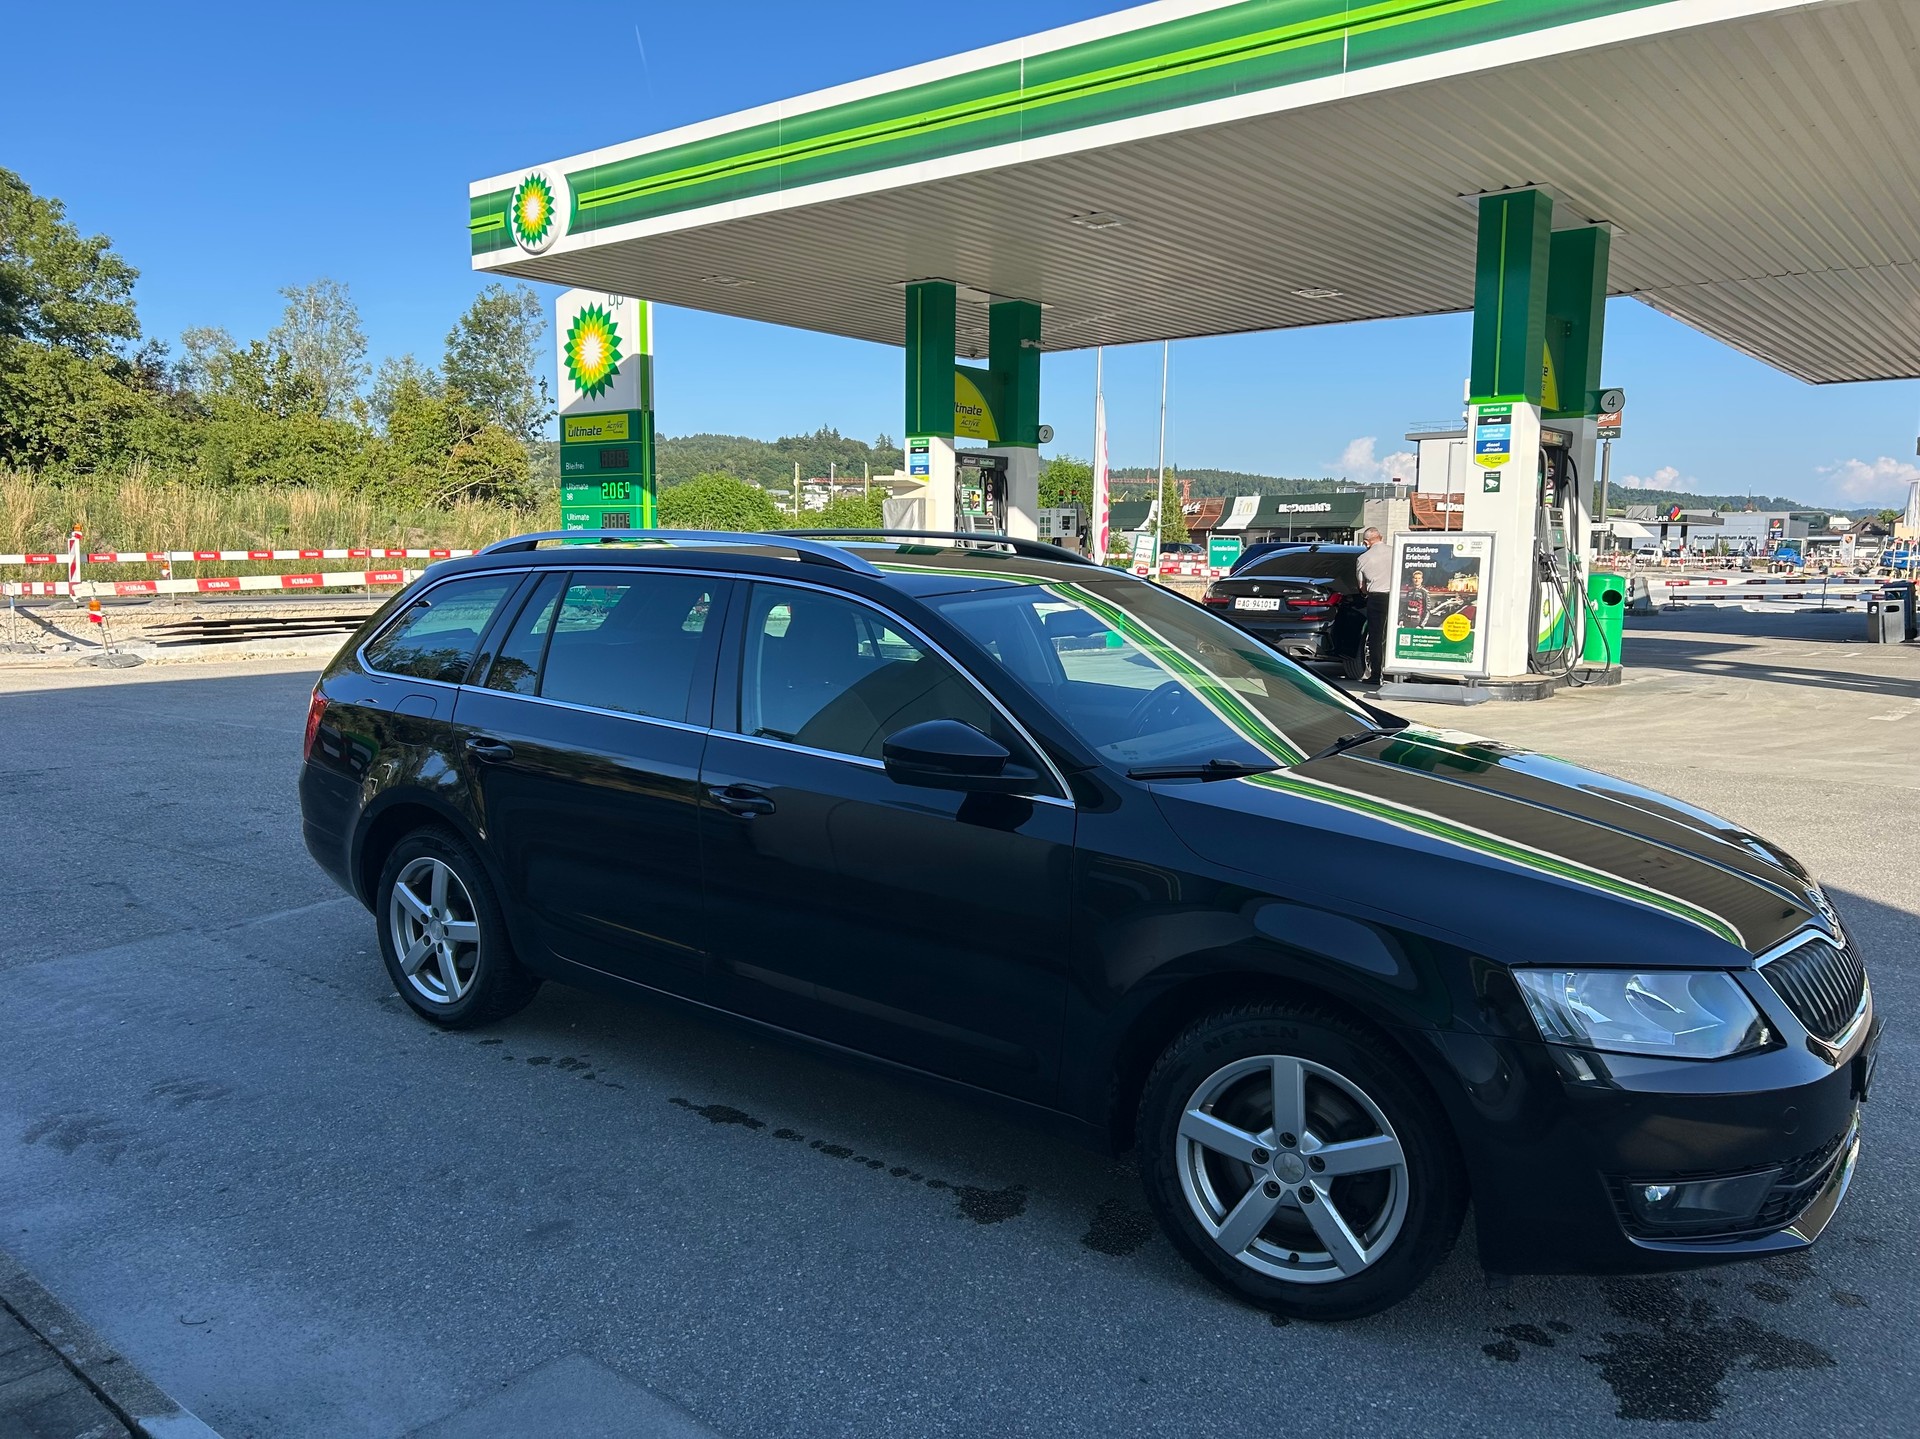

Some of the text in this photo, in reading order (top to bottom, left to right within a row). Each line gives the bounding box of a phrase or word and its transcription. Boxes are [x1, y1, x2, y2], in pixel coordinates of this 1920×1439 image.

[1607, 395, 1616, 408] 4
[568, 425, 603, 437] ultimate
[1043, 429, 1049, 439] 2
[1278, 502, 1332, 513] McDonald's
[566, 513, 590, 521] Ultimate
[1405, 553, 1431, 561] Erlebnis
[291, 577, 314, 585] KIBAG
[375, 573, 398, 581] KIBAG
[125, 584, 147, 592] KIBAG
[1242, 599, 1272, 609] AG 94101
[1202, 1024, 1300, 1054] NEXEN
